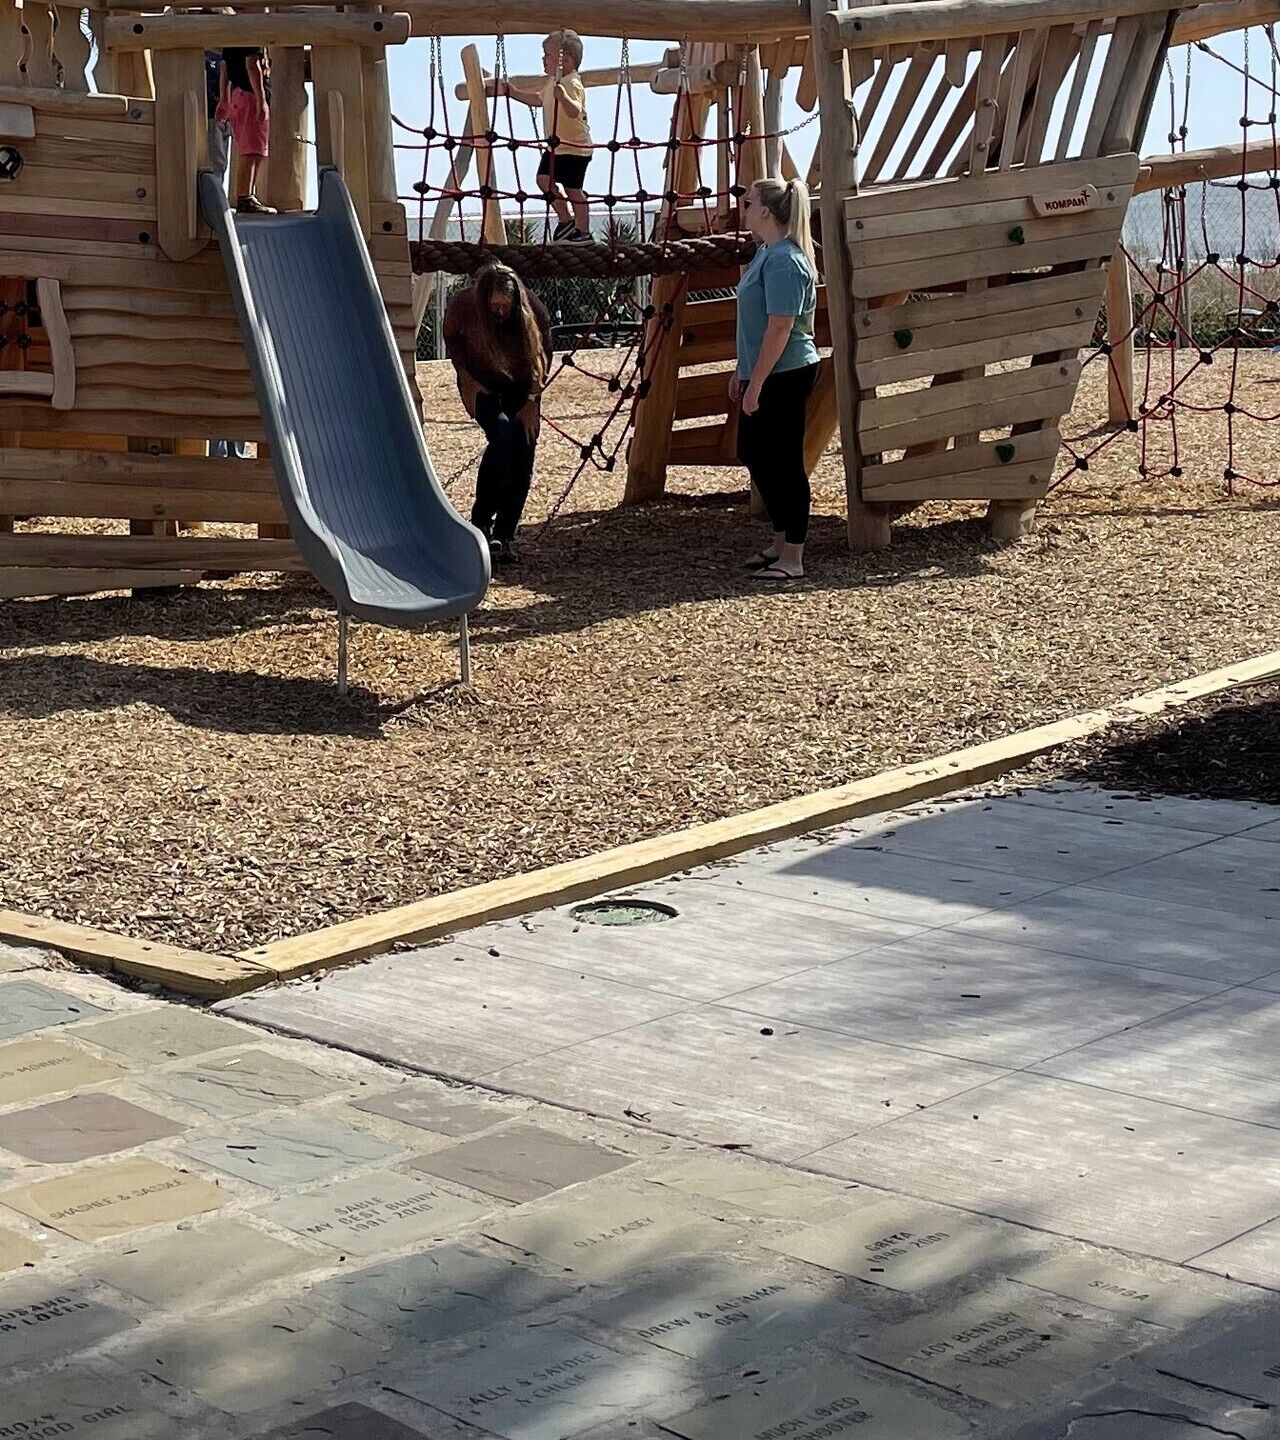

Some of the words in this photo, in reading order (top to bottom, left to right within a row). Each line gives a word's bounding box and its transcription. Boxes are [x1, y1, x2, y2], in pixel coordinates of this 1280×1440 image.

[1045, 196, 1085, 211] KOMPAN
[338, 1208, 381, 1226] BEST
[21, 1301, 91, 1327] LOVED
[636, 1316, 691, 1339] DREW
[952, 1310, 1022, 1344] BENTLEY
[80, 1403, 134, 1424] GIRL
[805, 1396, 860, 1421] LOVED
[792, 1410, 874, 1440] HOOTER
